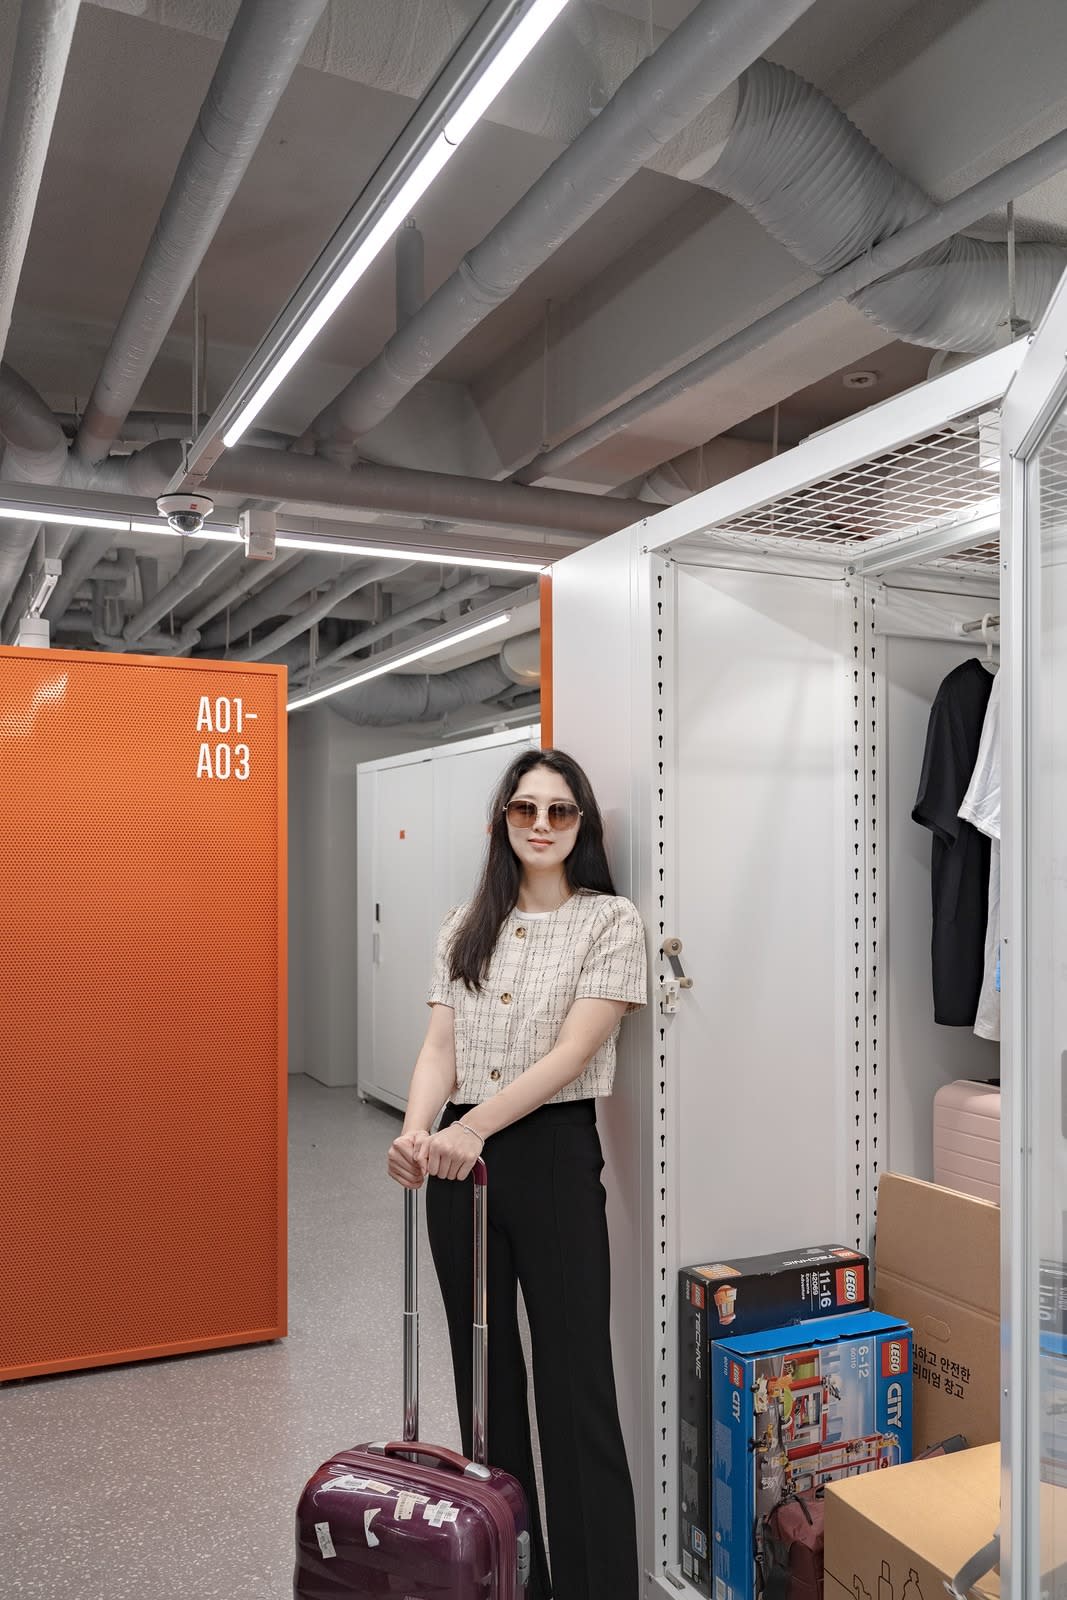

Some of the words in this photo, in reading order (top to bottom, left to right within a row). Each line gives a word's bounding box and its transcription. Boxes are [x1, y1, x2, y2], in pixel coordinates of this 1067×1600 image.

[196, 696, 258, 733] A01-
[196, 743, 250, 780] A03
[811, 1271, 819, 1296] 42069
[820, 1270, 832, 1308] 11-16
[844, 1268, 857, 1302] LEGO
[858, 1345, 870, 1379] 6-12
[888, 1341, 901, 1374] LEGO
[912, 1343, 937, 1367] 리하고
[940, 1357, 971, 1385] 안전한
[912, 1362, 941, 1389] 리미엄
[944, 1377, 965, 1400] 창고
[732, 1390, 741, 1423] CITY
[887, 1382, 902, 1429] CITY
